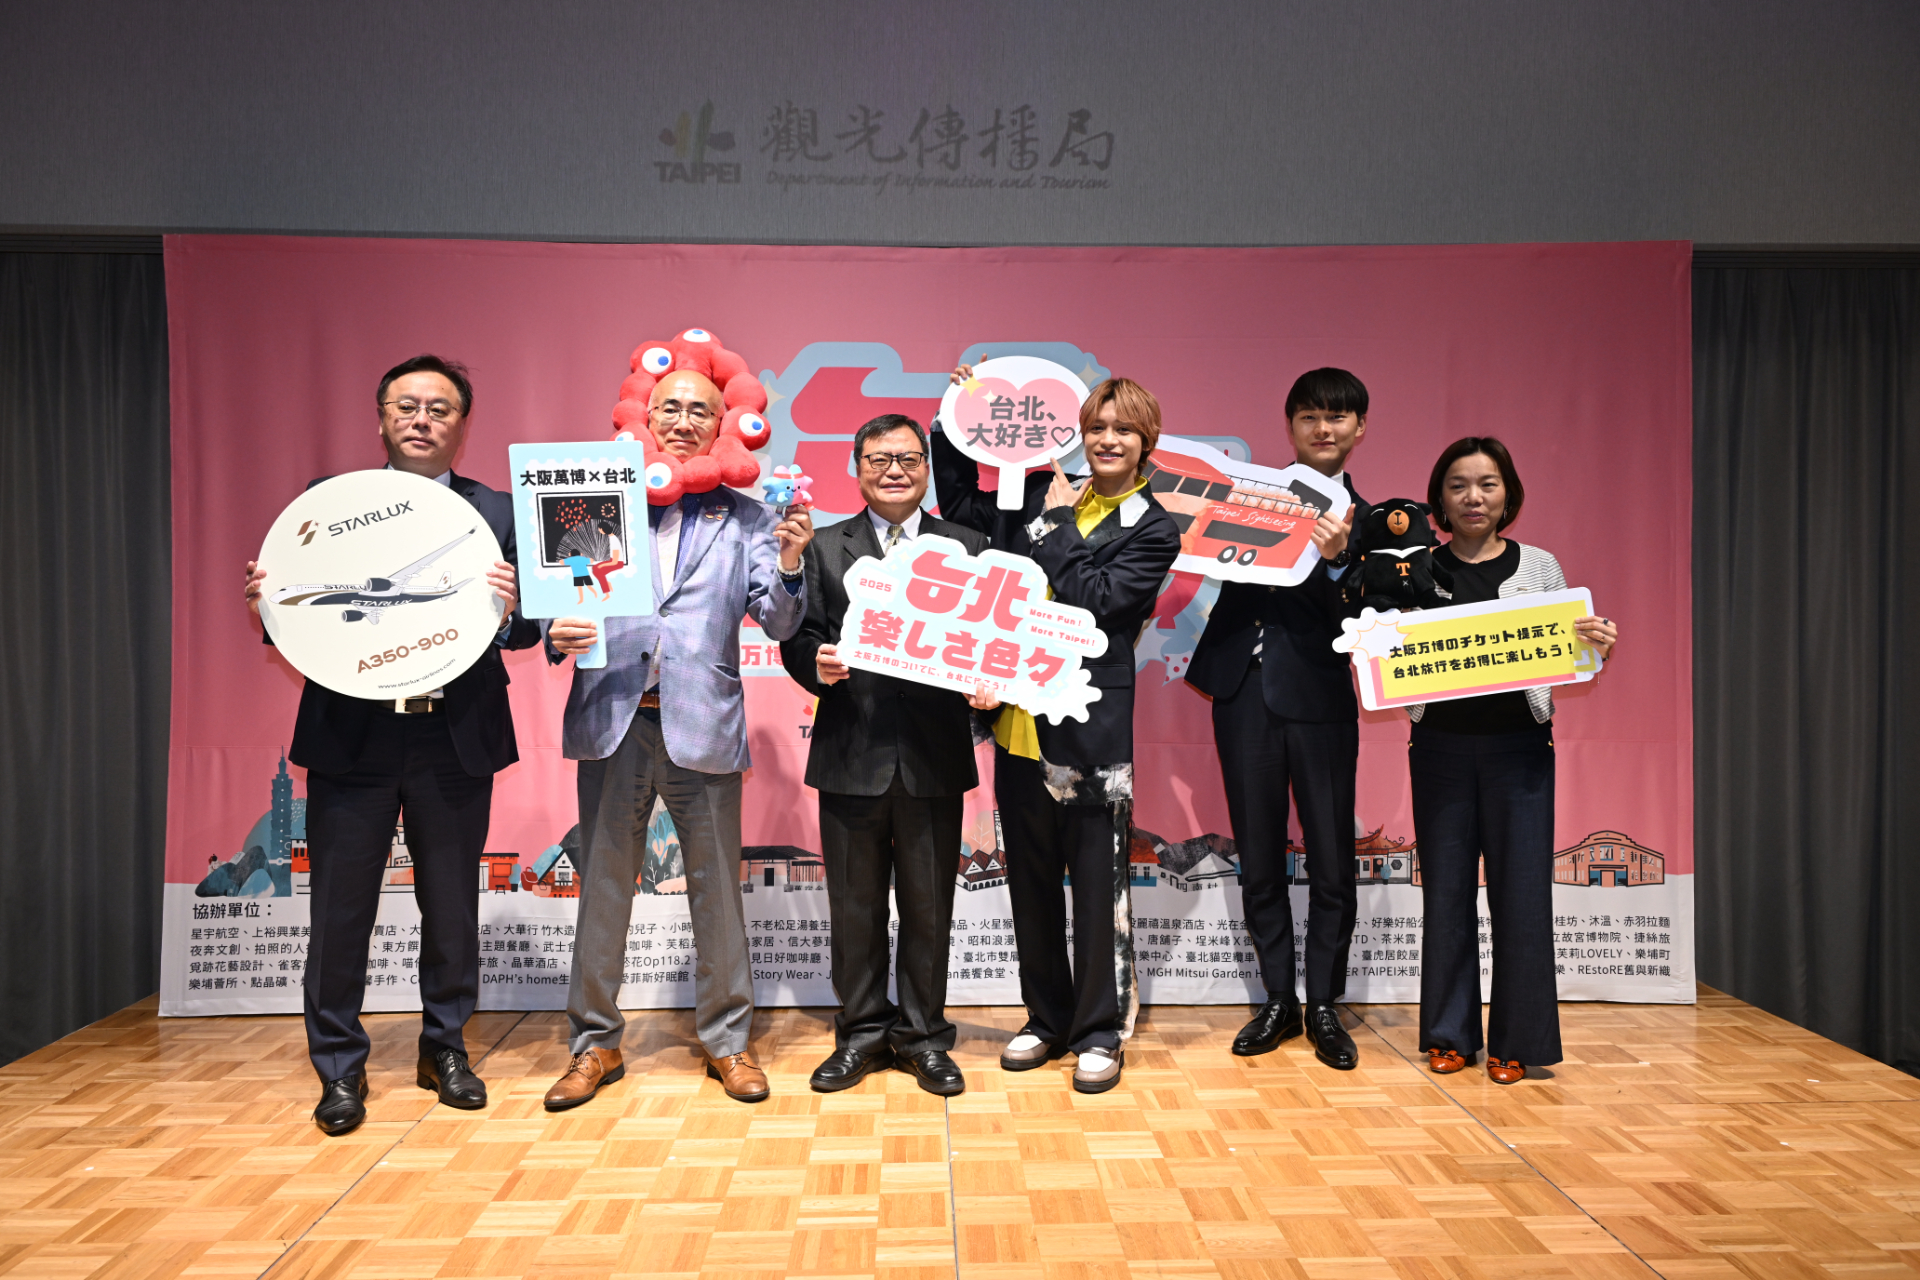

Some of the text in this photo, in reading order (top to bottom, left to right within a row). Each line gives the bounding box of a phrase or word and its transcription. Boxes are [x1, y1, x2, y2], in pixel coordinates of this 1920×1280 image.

[759, 100, 1115, 172] 觀光傳播局
[654, 160, 741, 184] TAIPEI
[765, 169, 1110, 195] Department of Information and Tourism
[989, 395, 1057, 423] 台北、
[328, 500, 414, 537] STARLUX
[1208, 504, 1297, 532] Taipei Sightseeing
[859, 577, 892, 593] 2025
[905, 549, 1031, 632] 台北
[350, 598, 413, 607] STARLUX
[1029, 608, 1082, 627] More Fun!
[858, 607, 1067, 688] 楽しさ色々
[1030, 625, 1096, 648] More Taipei!
[1389, 622, 1567, 659] 大阪万博のチケット提示で、
[357, 628, 459, 674] A350-900
[754, 970, 783, 982] Story
[1176, 968, 1208, 978] Mitsui
[1212, 968, 1251, 978] Garden
